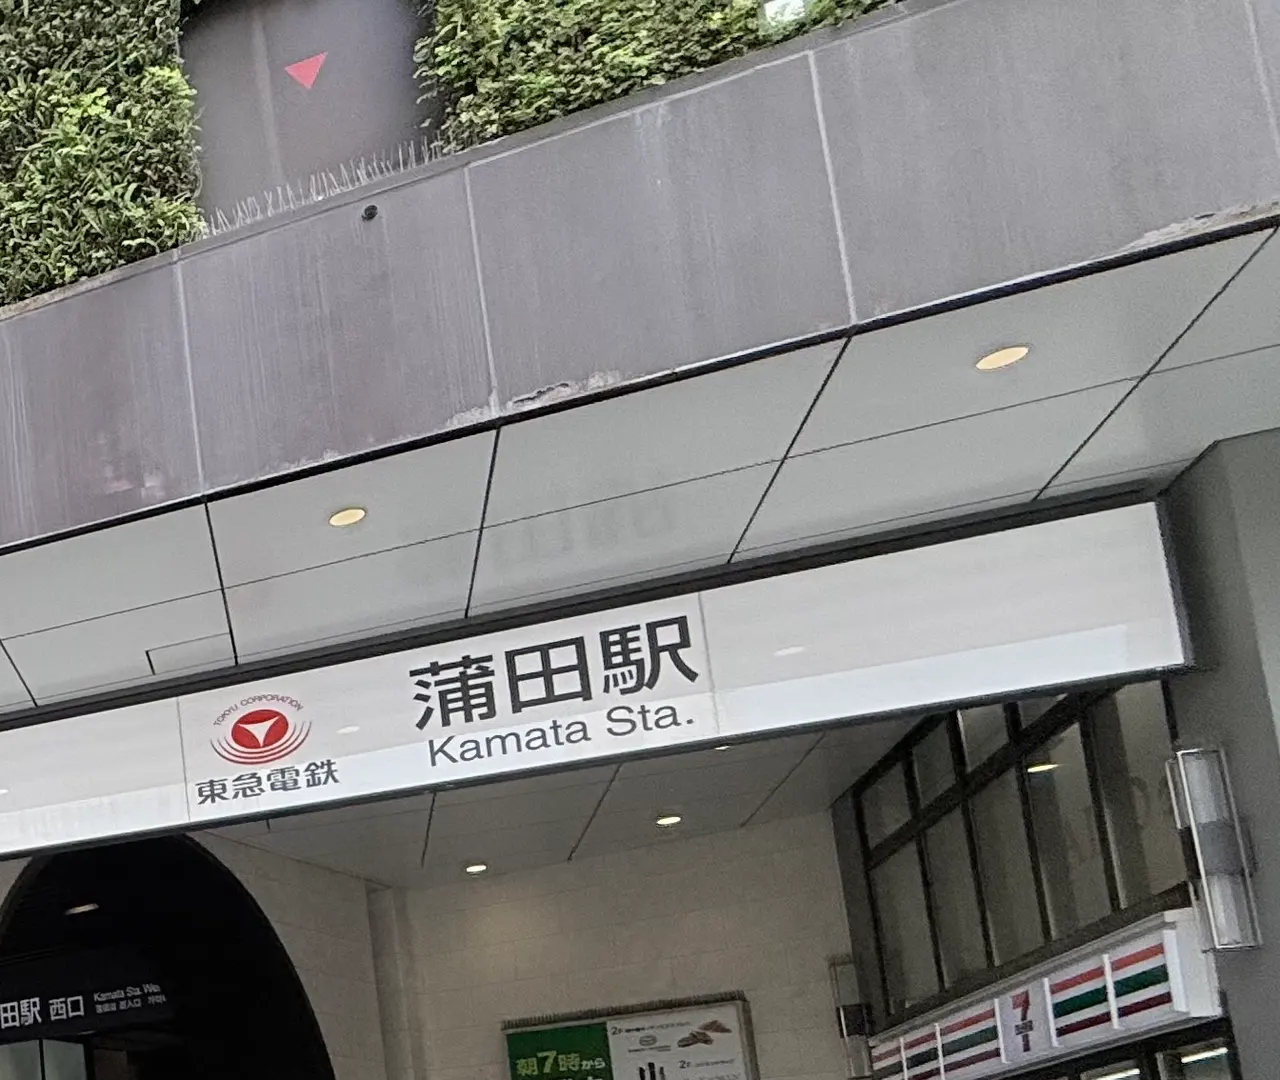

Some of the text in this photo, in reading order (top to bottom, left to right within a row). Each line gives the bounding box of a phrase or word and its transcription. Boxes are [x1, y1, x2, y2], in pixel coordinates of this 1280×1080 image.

[409, 615, 699, 730] 蒲田駅
[213, 694, 304, 727] TOKYU CORPORATION
[428, 704, 695, 767] Kamata Sta.
[194, 759, 340, 805] 東急電鉄
[48, 995, 85, 1022] 西口
[93, 988, 125, 1002] Kamata
[516, 1050, 606, 1076] 朝7時から
